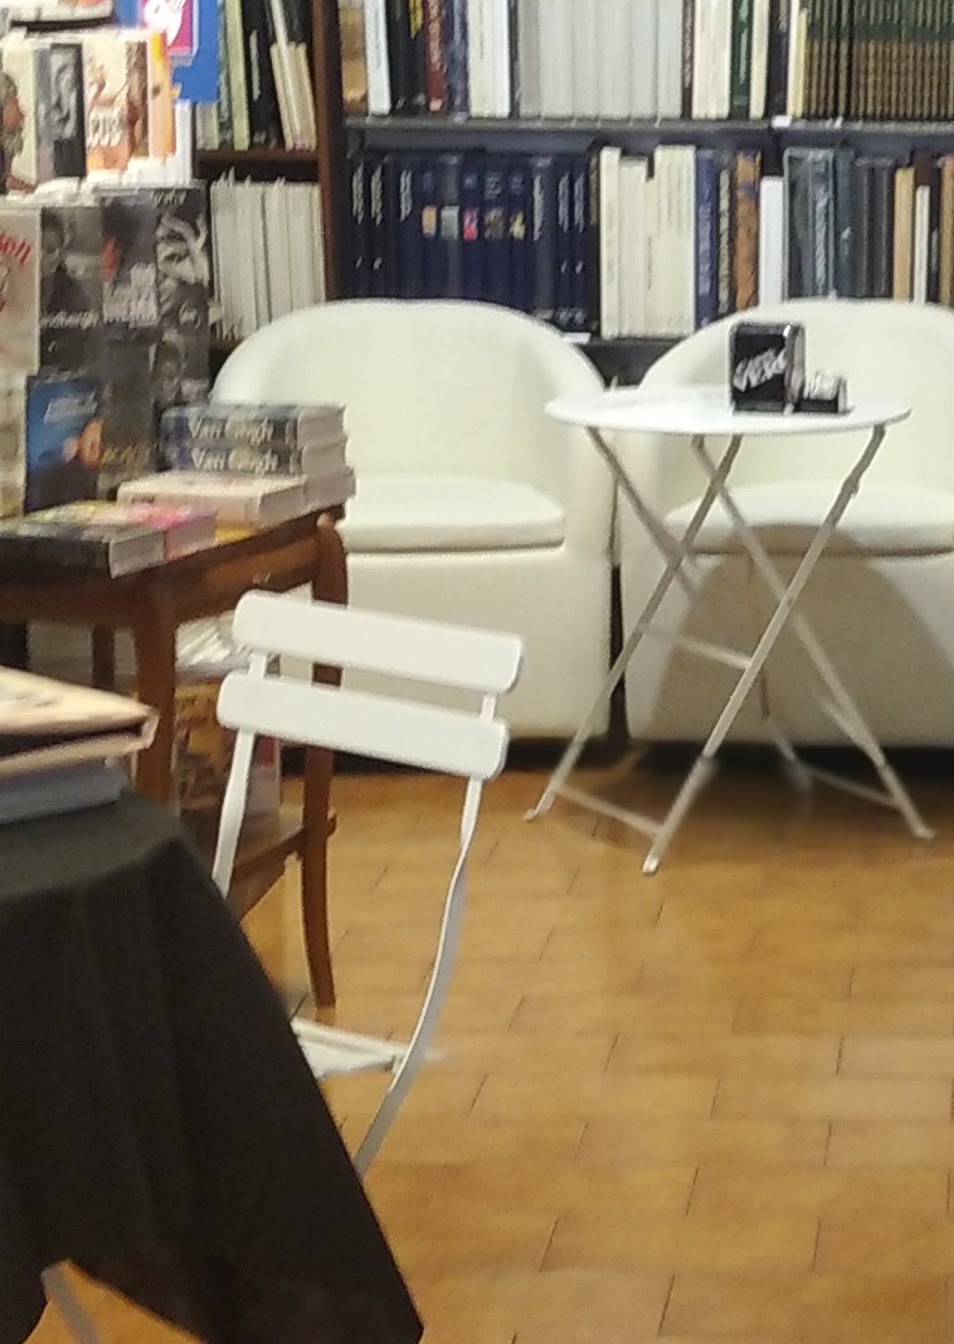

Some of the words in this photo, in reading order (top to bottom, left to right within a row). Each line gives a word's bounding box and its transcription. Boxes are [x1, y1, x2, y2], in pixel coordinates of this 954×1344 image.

[188, 415, 222, 438] Van
[224, 417, 273, 446] Gogh
[191, 447, 225, 469] Van
[228, 449, 278, 474] Gogh
